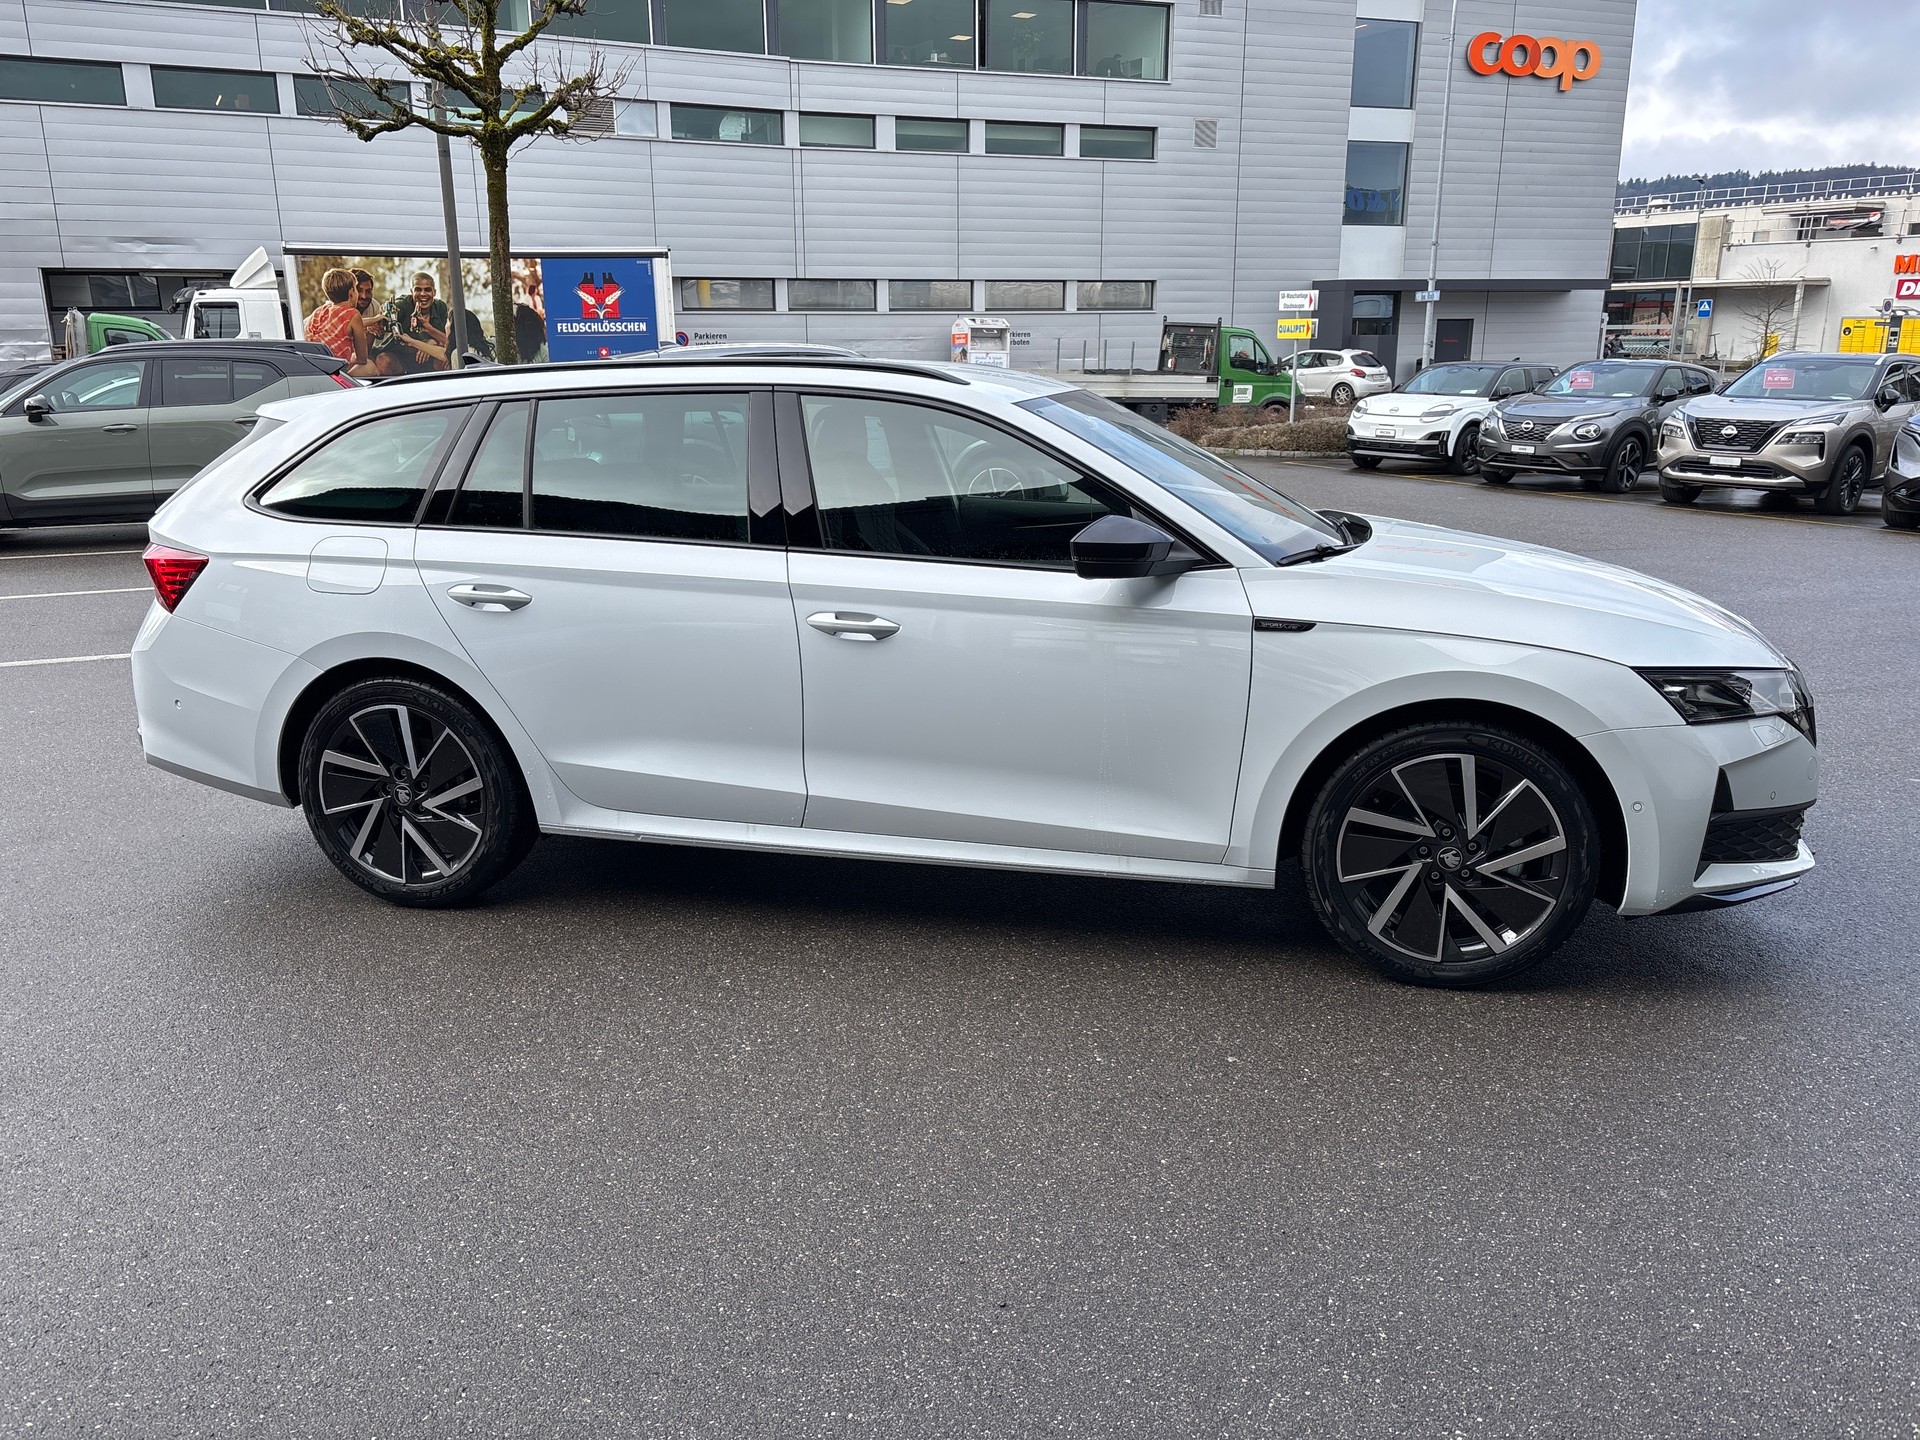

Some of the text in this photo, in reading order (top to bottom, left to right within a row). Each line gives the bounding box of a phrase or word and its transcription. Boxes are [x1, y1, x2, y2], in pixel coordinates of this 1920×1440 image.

[1468, 31, 1602, 91] coop
[557, 320, 647, 333] FELDSCHLÖSSCHEN
[1279, 324, 1305, 334] QUALIPET
[694, 332, 728, 340] Parkieren
